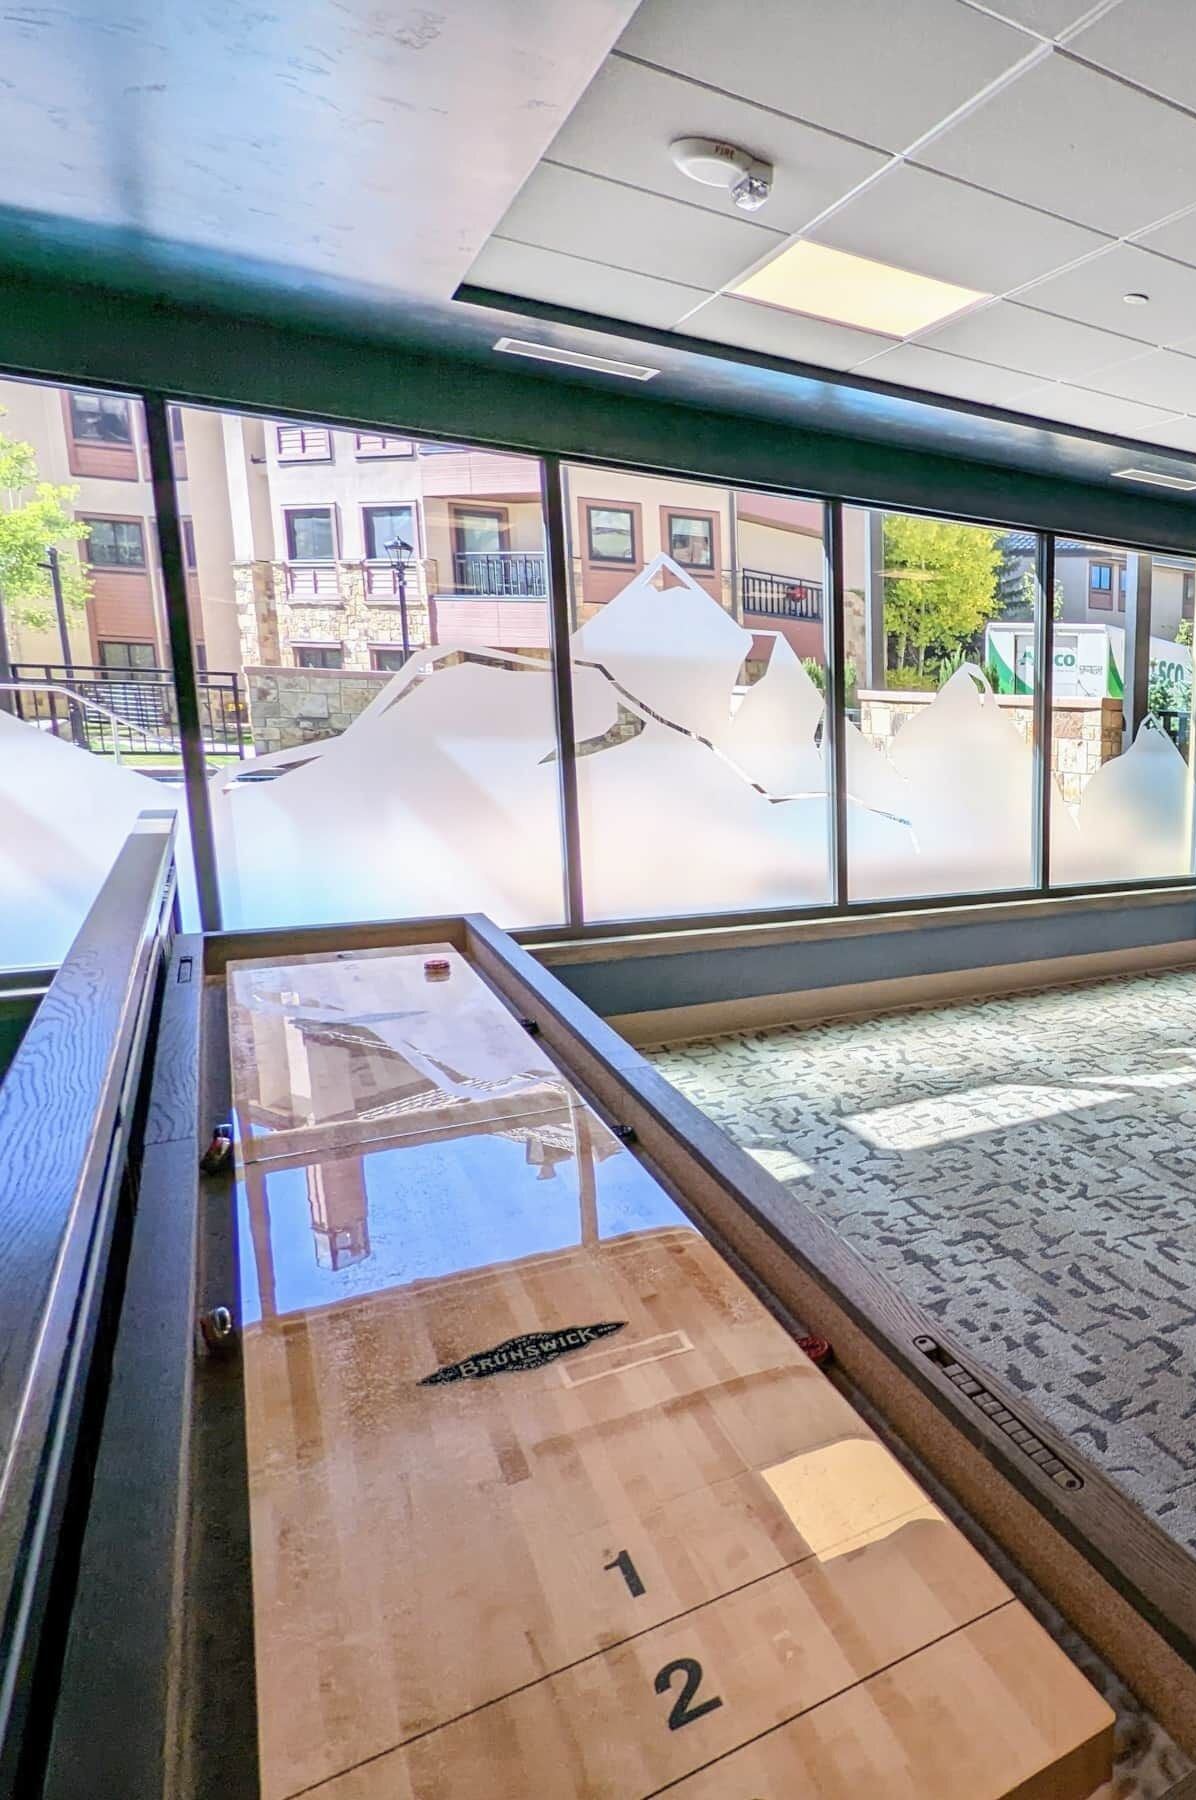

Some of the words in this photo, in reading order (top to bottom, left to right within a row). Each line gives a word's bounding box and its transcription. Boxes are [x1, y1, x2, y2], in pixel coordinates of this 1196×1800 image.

[715, 143, 735, 160] FIRE
[458, 1327, 597, 1378] BRUNSWICK
[603, 1549, 646, 1597] 1
[654, 1657, 723, 1731] 2
